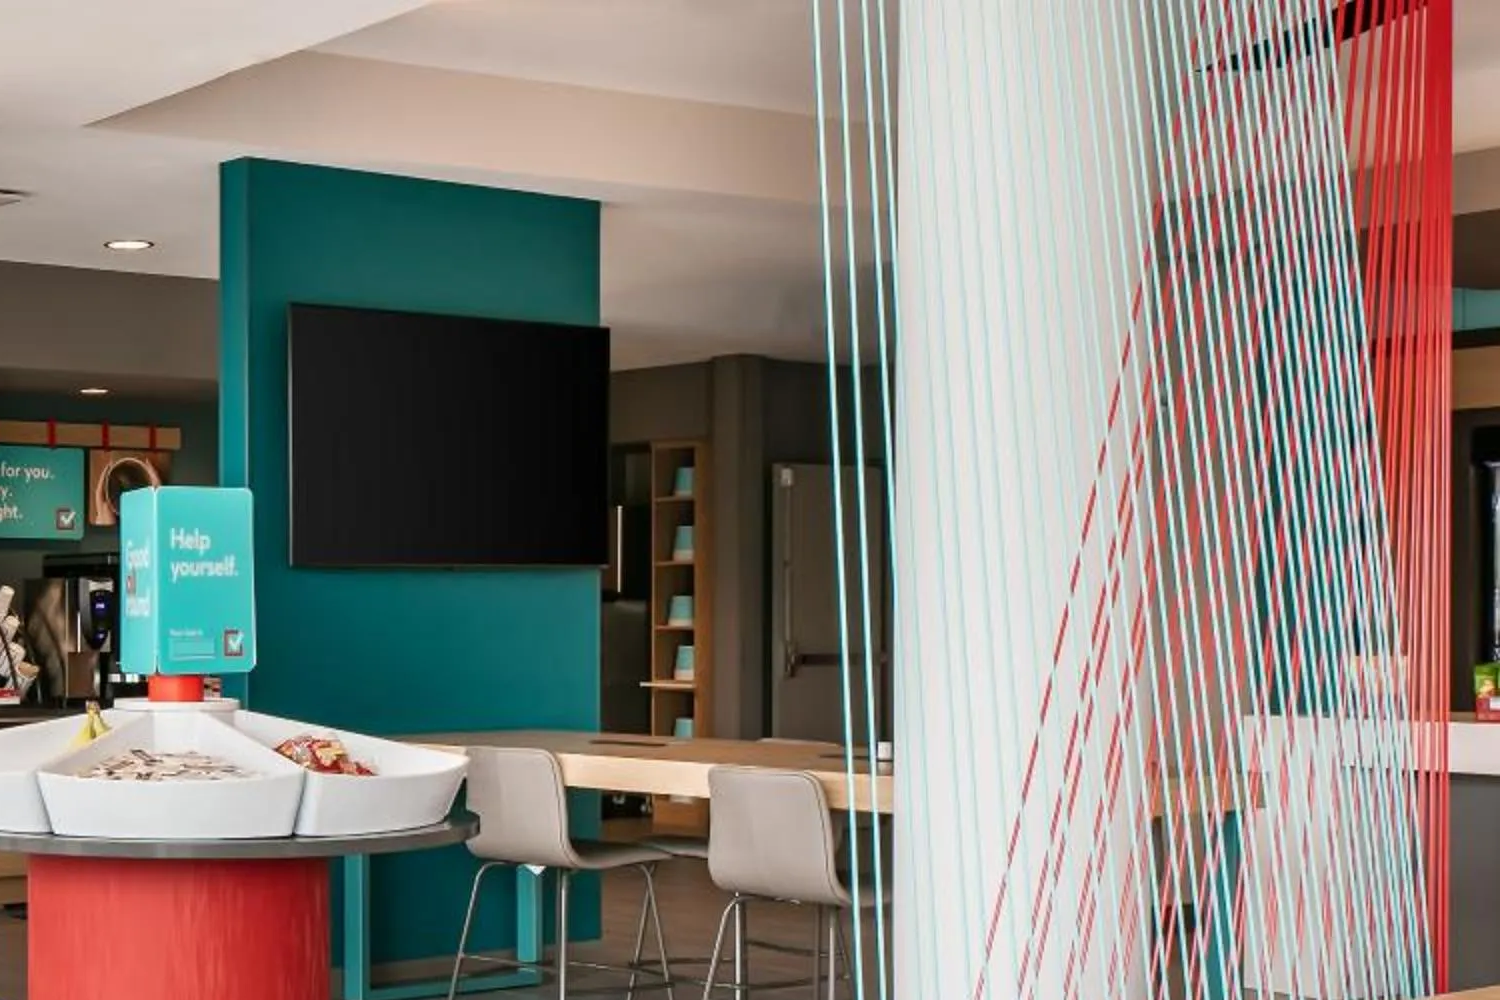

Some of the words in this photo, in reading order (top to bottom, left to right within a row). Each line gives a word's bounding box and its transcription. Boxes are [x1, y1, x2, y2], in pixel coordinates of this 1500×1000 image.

[0, 461, 21, 478] for
[24, 465, 55, 483] you.
[170, 527, 211, 556] Help
[170, 553, 239, 583] yourself.
